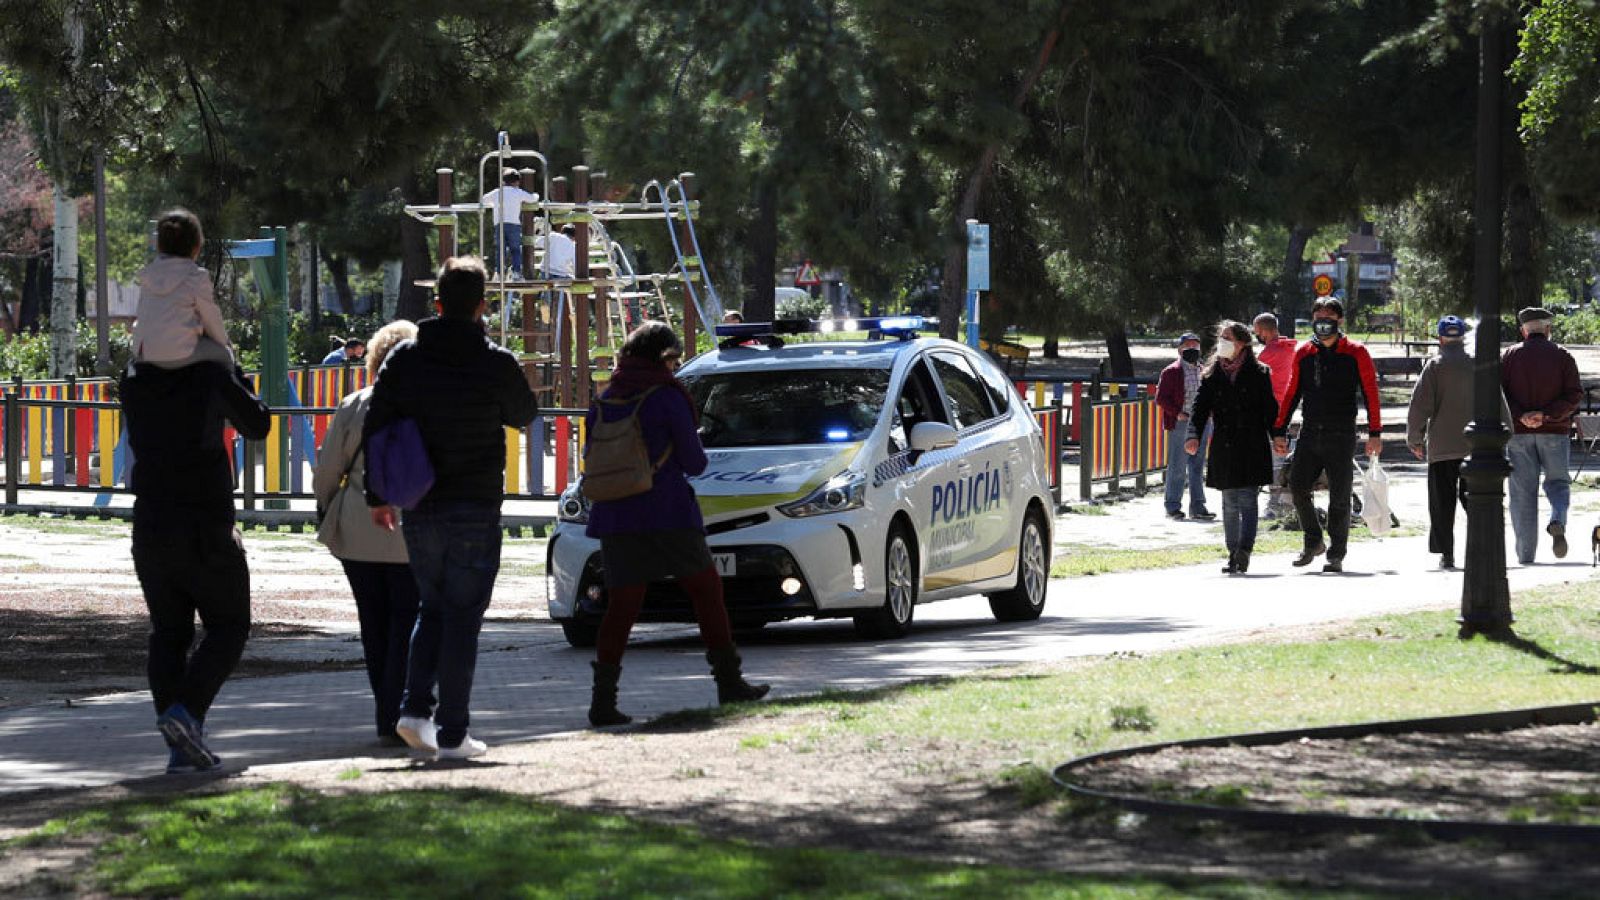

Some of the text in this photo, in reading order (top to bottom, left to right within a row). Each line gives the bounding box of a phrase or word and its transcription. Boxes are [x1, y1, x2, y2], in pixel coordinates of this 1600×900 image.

[930, 461, 1001, 528] POLICÍA
[929, 519, 976, 553] MUNICIPAL
[713, 555, 729, 573] Y
